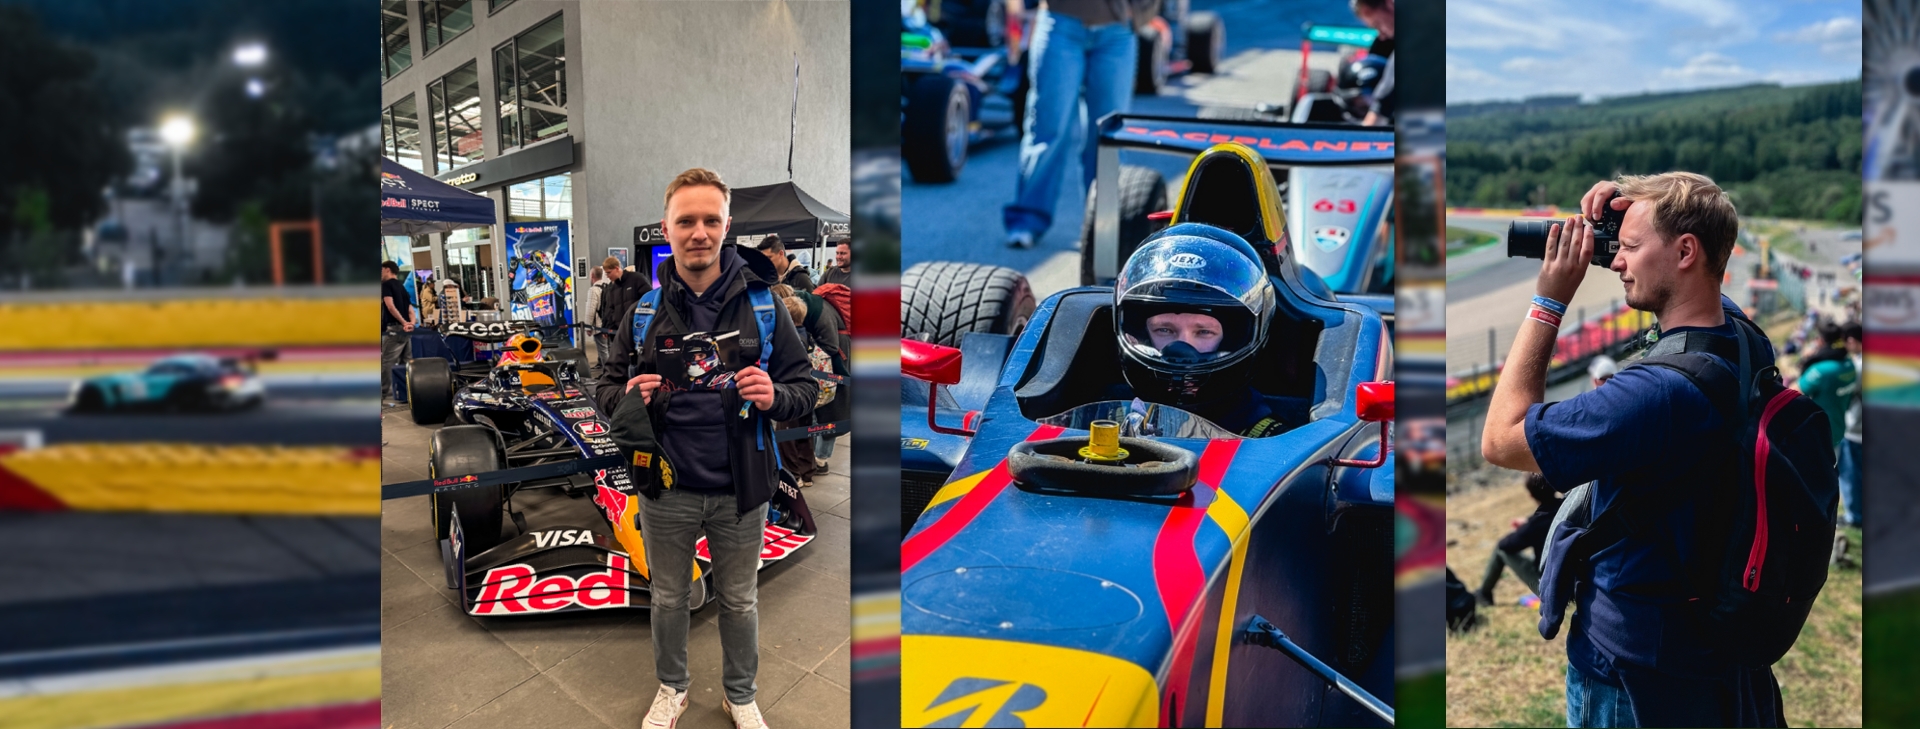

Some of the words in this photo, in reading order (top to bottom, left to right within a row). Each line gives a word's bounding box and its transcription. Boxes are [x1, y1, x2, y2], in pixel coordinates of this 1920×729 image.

[411, 198, 440, 209] SPECT
[1312, 197, 1358, 216] 63
[1171, 255, 1203, 266] JEXX
[778, 479, 798, 500] AT&T
[529, 529, 595, 549] VISA
[468, 550, 630, 616] Red
